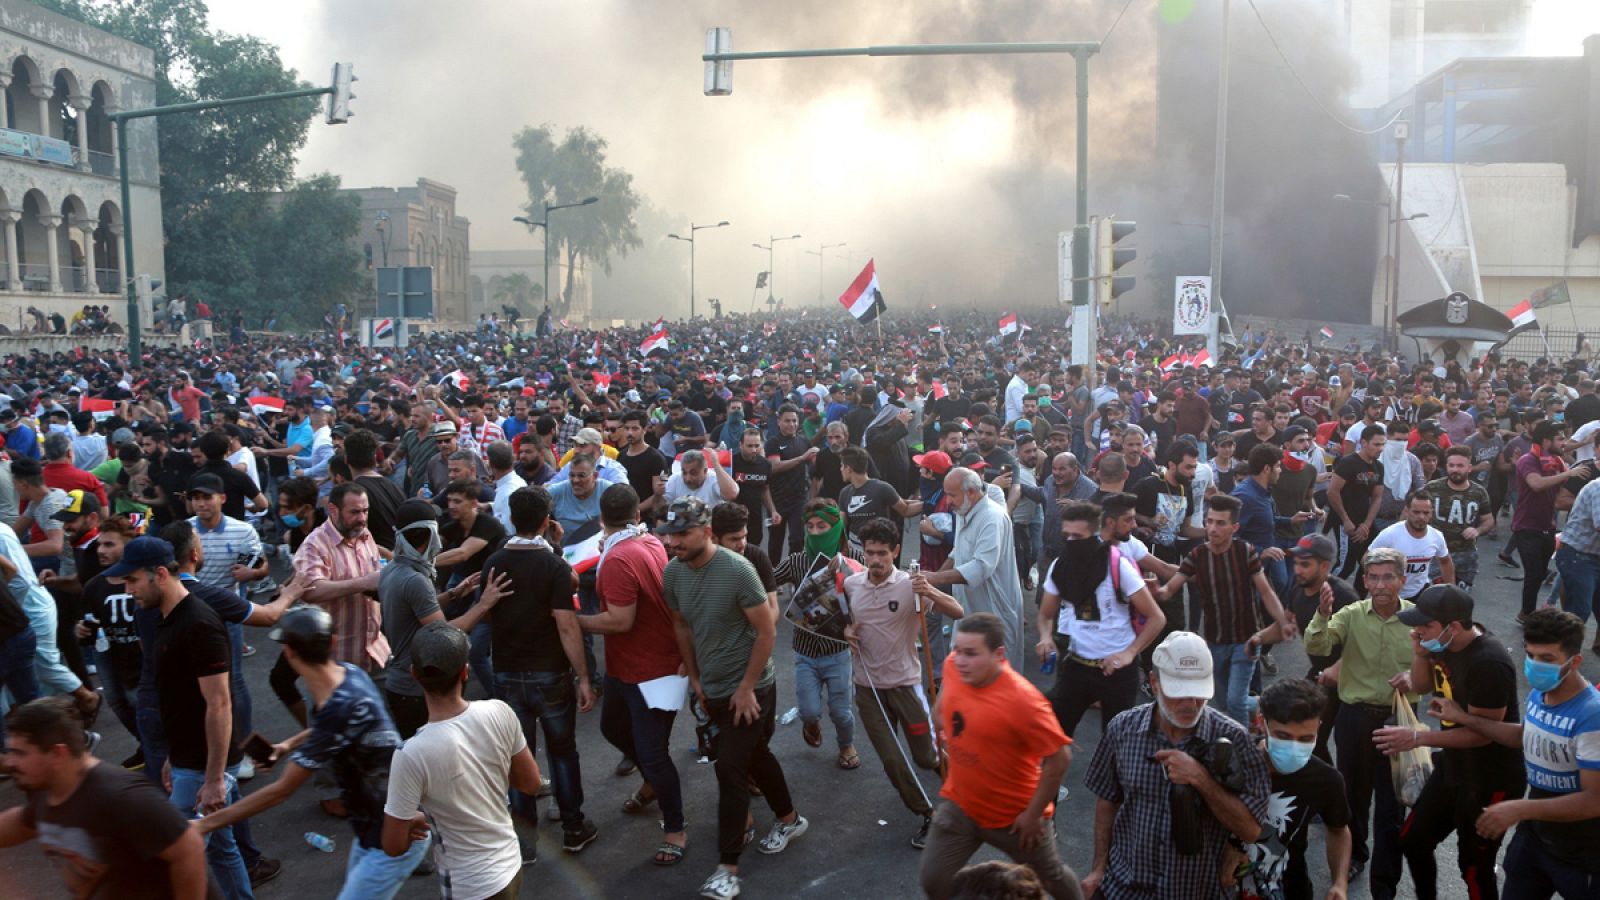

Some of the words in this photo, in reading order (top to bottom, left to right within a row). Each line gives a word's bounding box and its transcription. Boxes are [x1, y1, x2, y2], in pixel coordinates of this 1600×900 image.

[851, 496, 866, 504] NIKE
[1406, 563, 1426, 573] ILA
[1536, 771, 1577, 789] CONTENT
